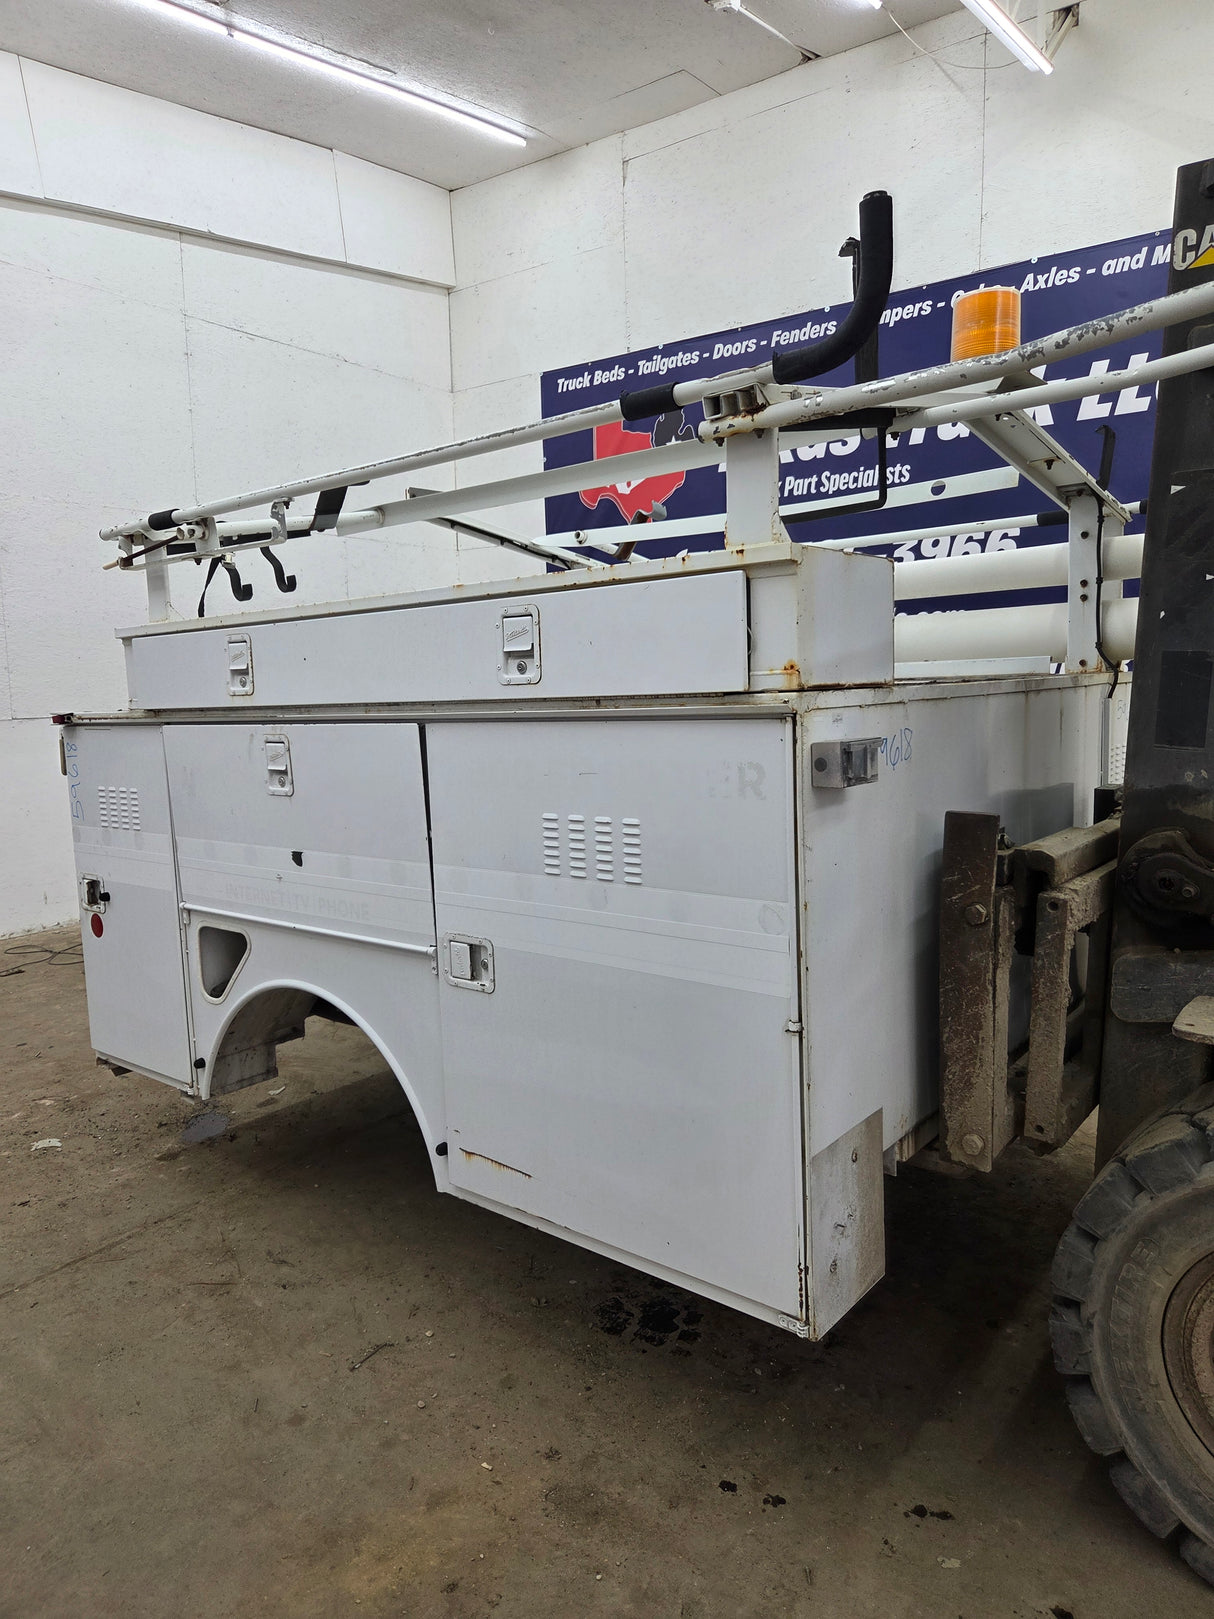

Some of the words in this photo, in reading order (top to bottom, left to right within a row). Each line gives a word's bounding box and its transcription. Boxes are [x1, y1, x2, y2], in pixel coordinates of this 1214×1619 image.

[557, 372, 591, 393] Truck
[593, 365, 625, 385] Beds
[637, 349, 700, 376] Tailgates
[712, 337, 757, 360] Doors
[770, 319, 837, 348] Fenders
[1019, 266, 1080, 293] Axles
[1102, 247, 1147, 276] and
[783, 475, 818, 497] Part
[819, 463, 911, 495] Specialsts
[317, 897, 370, 919] PHONE
